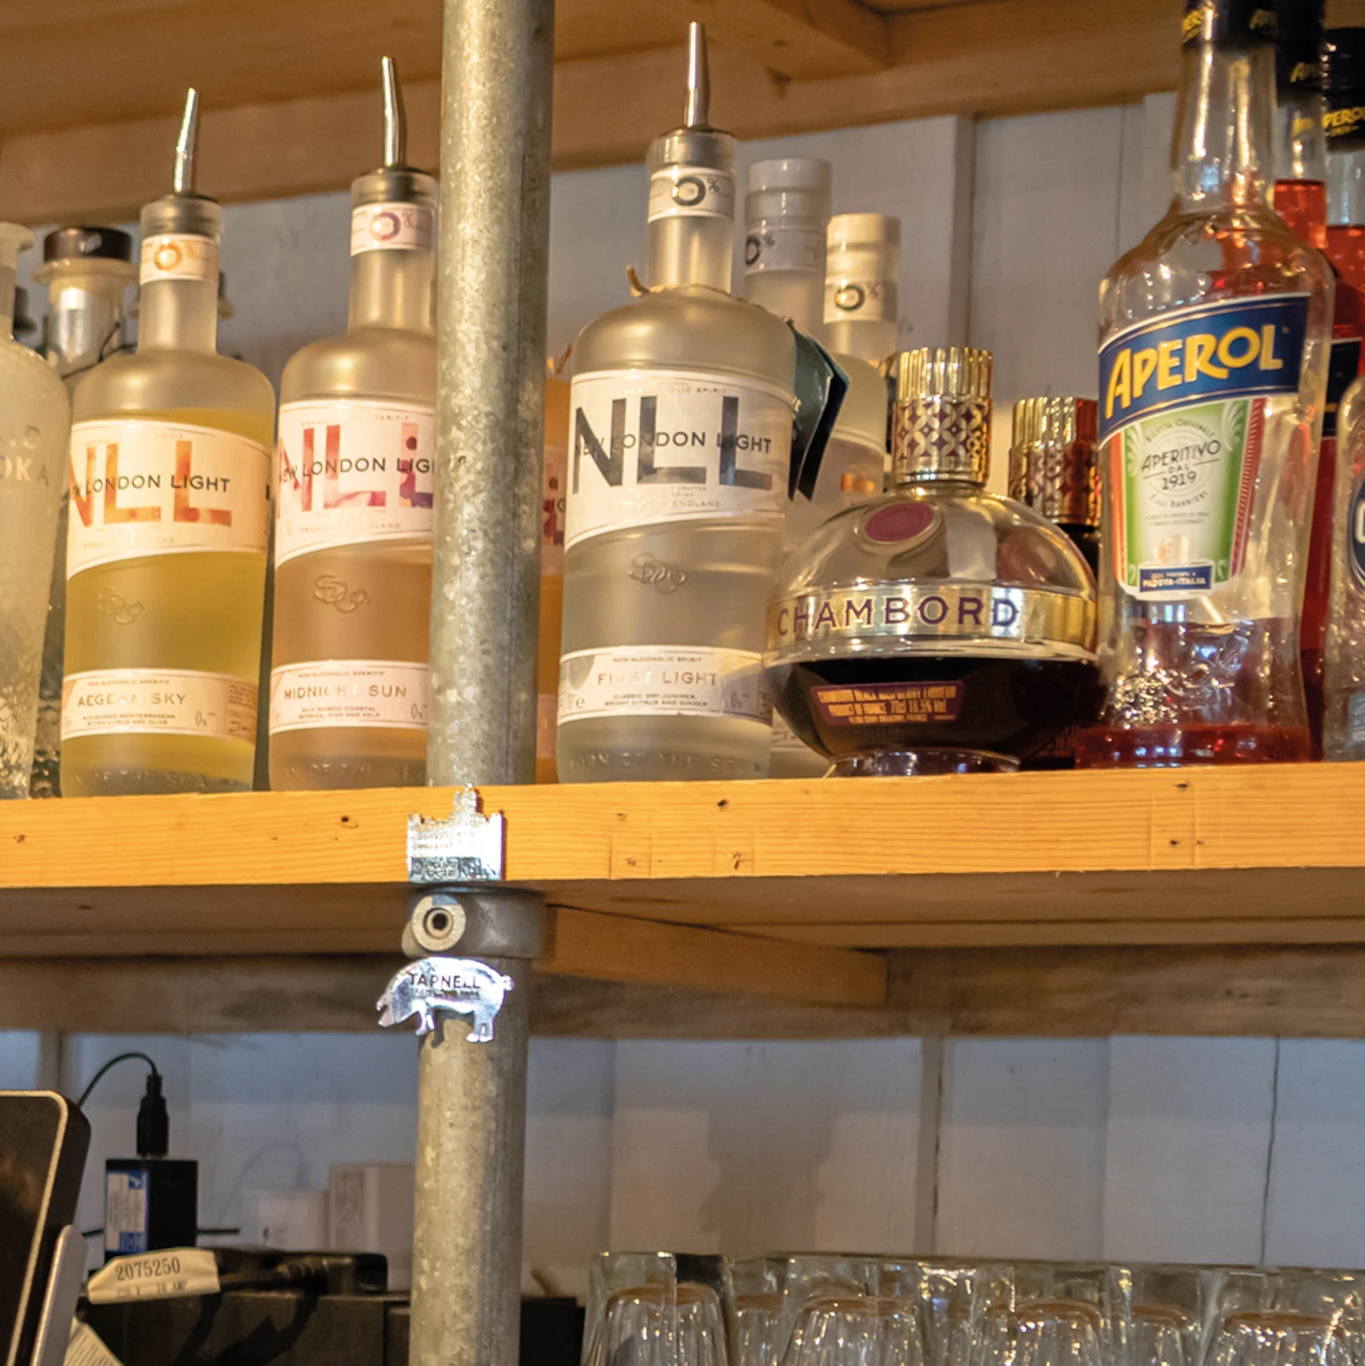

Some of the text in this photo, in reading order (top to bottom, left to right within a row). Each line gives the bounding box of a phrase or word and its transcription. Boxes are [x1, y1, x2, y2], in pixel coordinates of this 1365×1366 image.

[1105, 324, 1283, 419] APEROL
[572, 396, 773, 494] NLL
[1141, 440, 1221, 473] APERITIVO
[302, 457, 435, 478] LONDON LIG
[86, 474, 161, 495] LONDON
[170, 474, 231, 493] LIGHT
[1162, 470, 1197, 491] 1919
[777, 595, 1020, 637] CHAMBORD
[663, 671, 718, 686] LIGHT
[151, 692, 187, 706] SKY
[368, 684, 407, 699] SUN
[115, 1257, 181, 1281] 2075250
